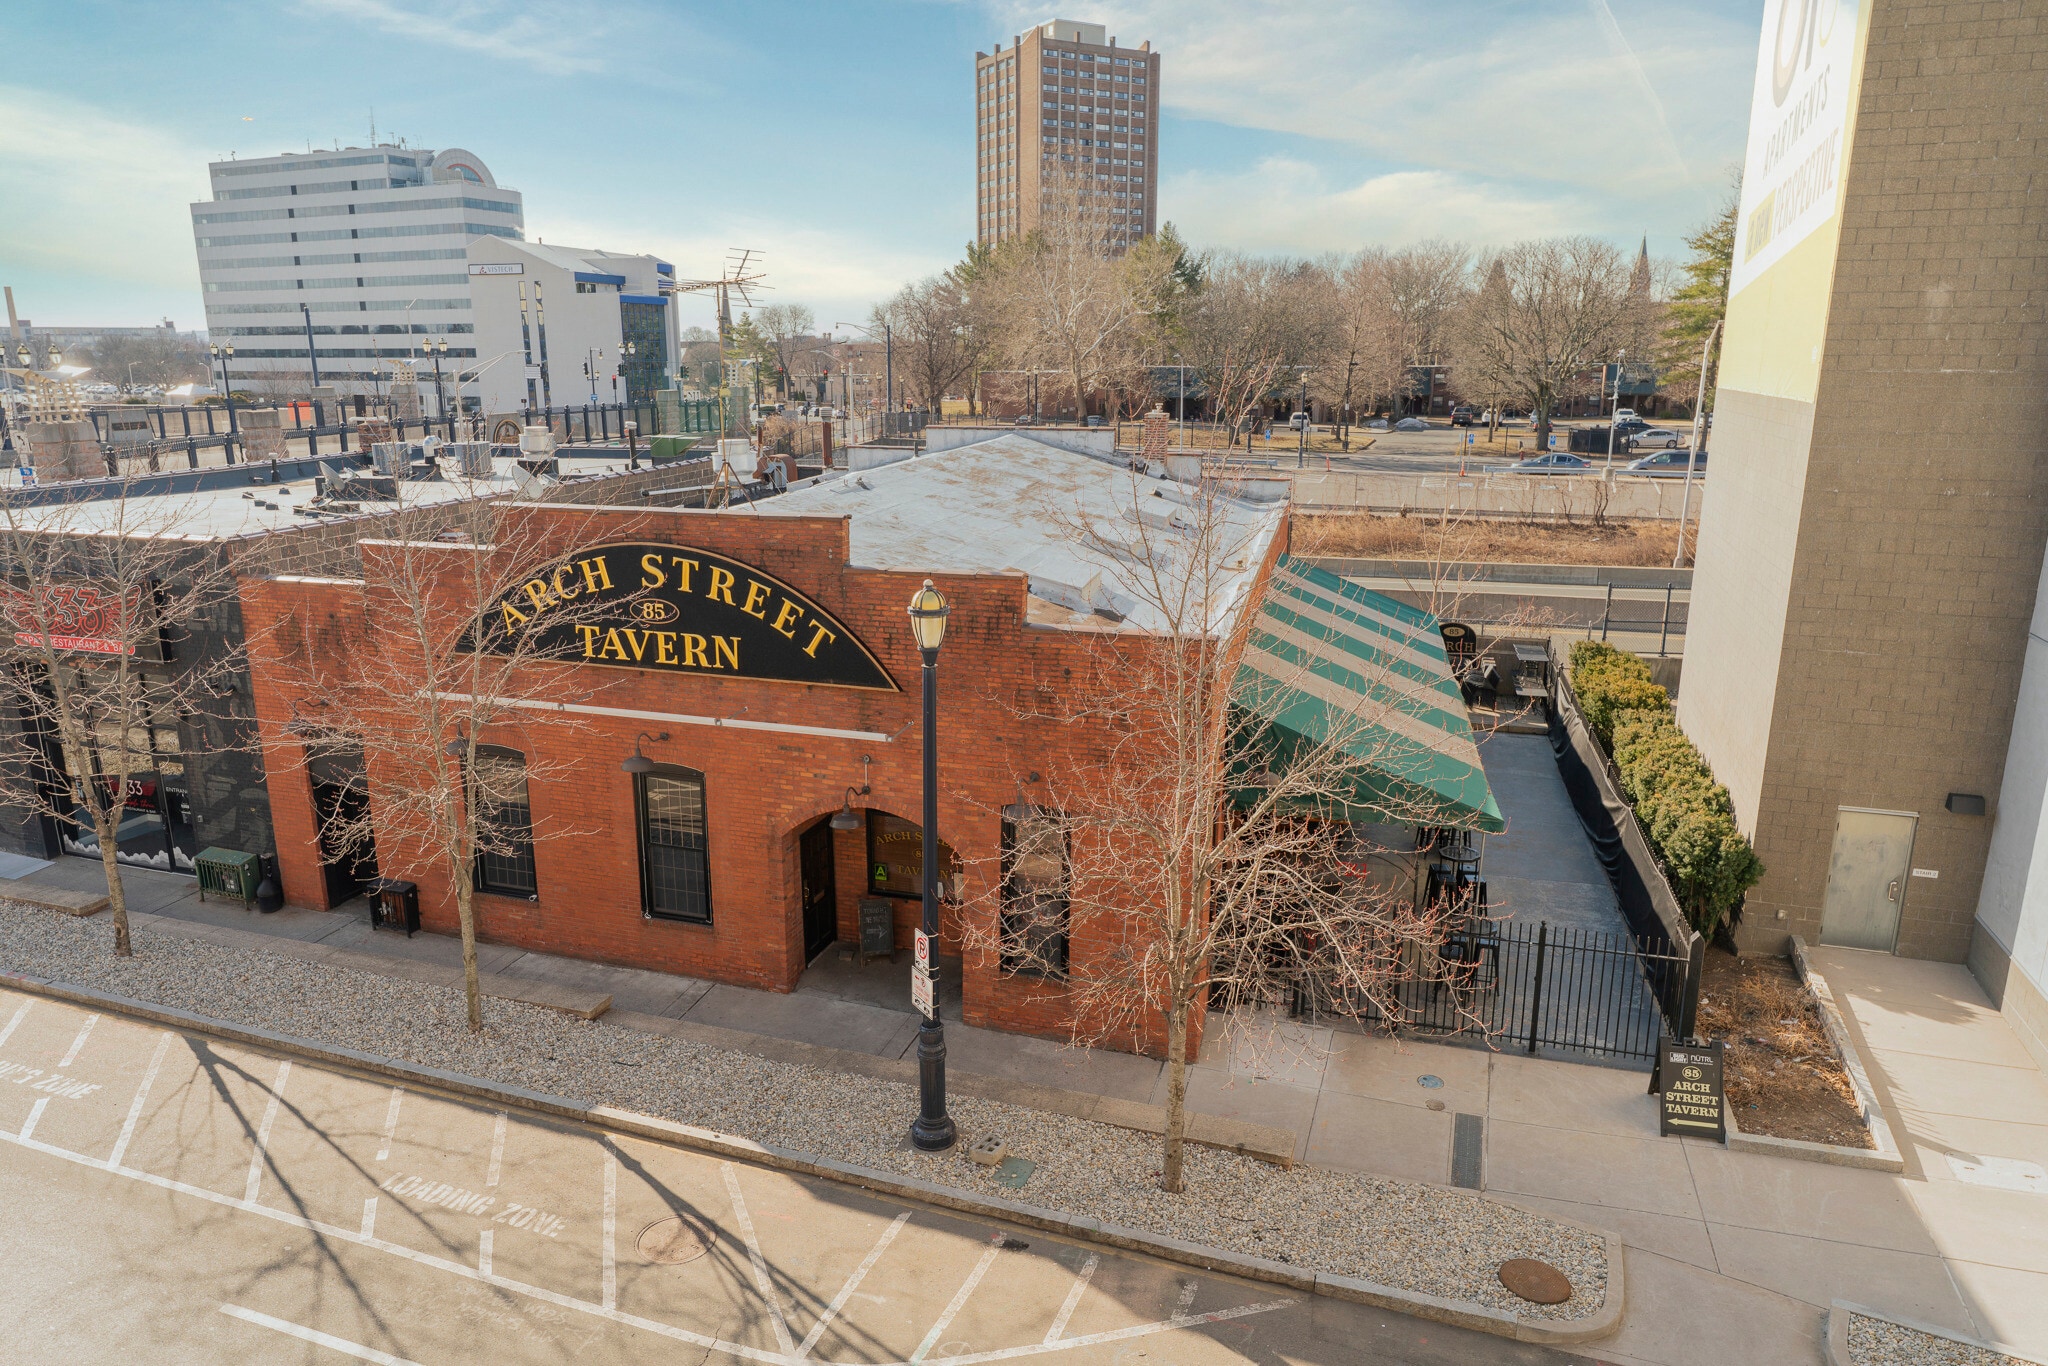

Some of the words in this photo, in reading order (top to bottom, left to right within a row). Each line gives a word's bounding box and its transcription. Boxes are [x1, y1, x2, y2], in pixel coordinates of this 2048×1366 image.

[1762, 64, 1830, 180] APARTMENTS
[1772, 127, 1839, 241] PERSPECTIVE
[501, 555, 614, 636] ARCH
[640, 553, 836, 659] STREET
[642, 602, 665, 619] 85
[574, 624, 742, 670] TAVERN
[1446, 641, 1474, 652] RCH
[125, 780, 143, 796] 33
[876, 831, 911, 846] ARCH
[896, 864, 949, 880] TAVN
[1684, 1069, 1699, 1078] 85
[1673, 1081, 1710, 1092] ARCH
[1666, 1092, 1718, 1105] STREET
[1666, 1104, 1718, 1117] TAVERN
[379, 1171, 496, 1217] LOADING
[490, 1202, 567, 1238] ZONE
